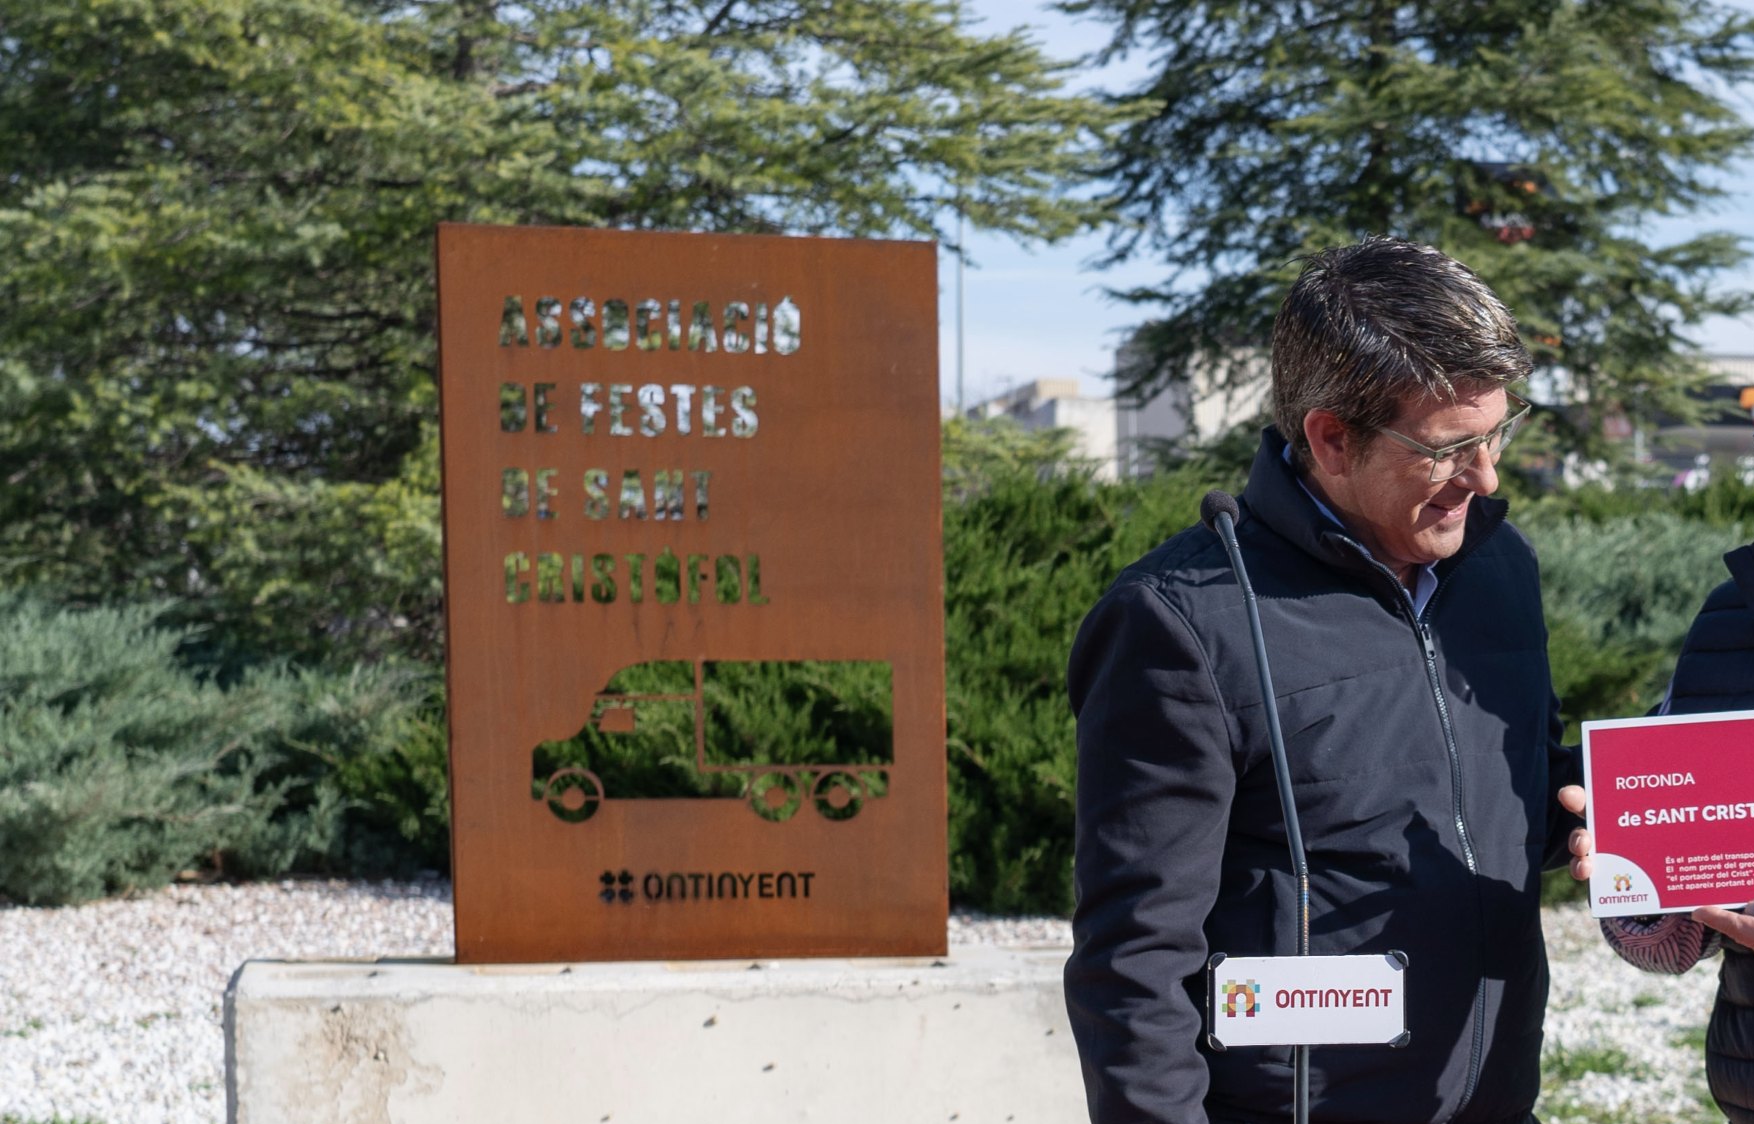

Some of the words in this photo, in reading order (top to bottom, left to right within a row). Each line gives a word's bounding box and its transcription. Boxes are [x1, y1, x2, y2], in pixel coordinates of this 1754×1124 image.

[499, 295, 801, 355] ASSOCIACIÓ
[499, 383, 557, 435] DE
[579, 383, 760, 439] FESTES
[501, 468, 560, 521] DE
[583, 468, 713, 522] SANT
[1616, 772, 1695, 790] ROTONDA
[1618, 811, 1641, 827] de
[1644, 807, 1698, 825] SANT
[1688, 855, 1710, 863] patró
[1724, 861, 1736, 869] del
[643, 871, 816, 900] ONTINYENT
[1680, 873, 1714, 882] portador
[1685, 882, 1714, 890] apareix
[1715, 879, 1745, 888] portant
[1598, 893, 1649, 905] ONTINYENT
[1275, 987, 1392, 1009] ONTINYENT
